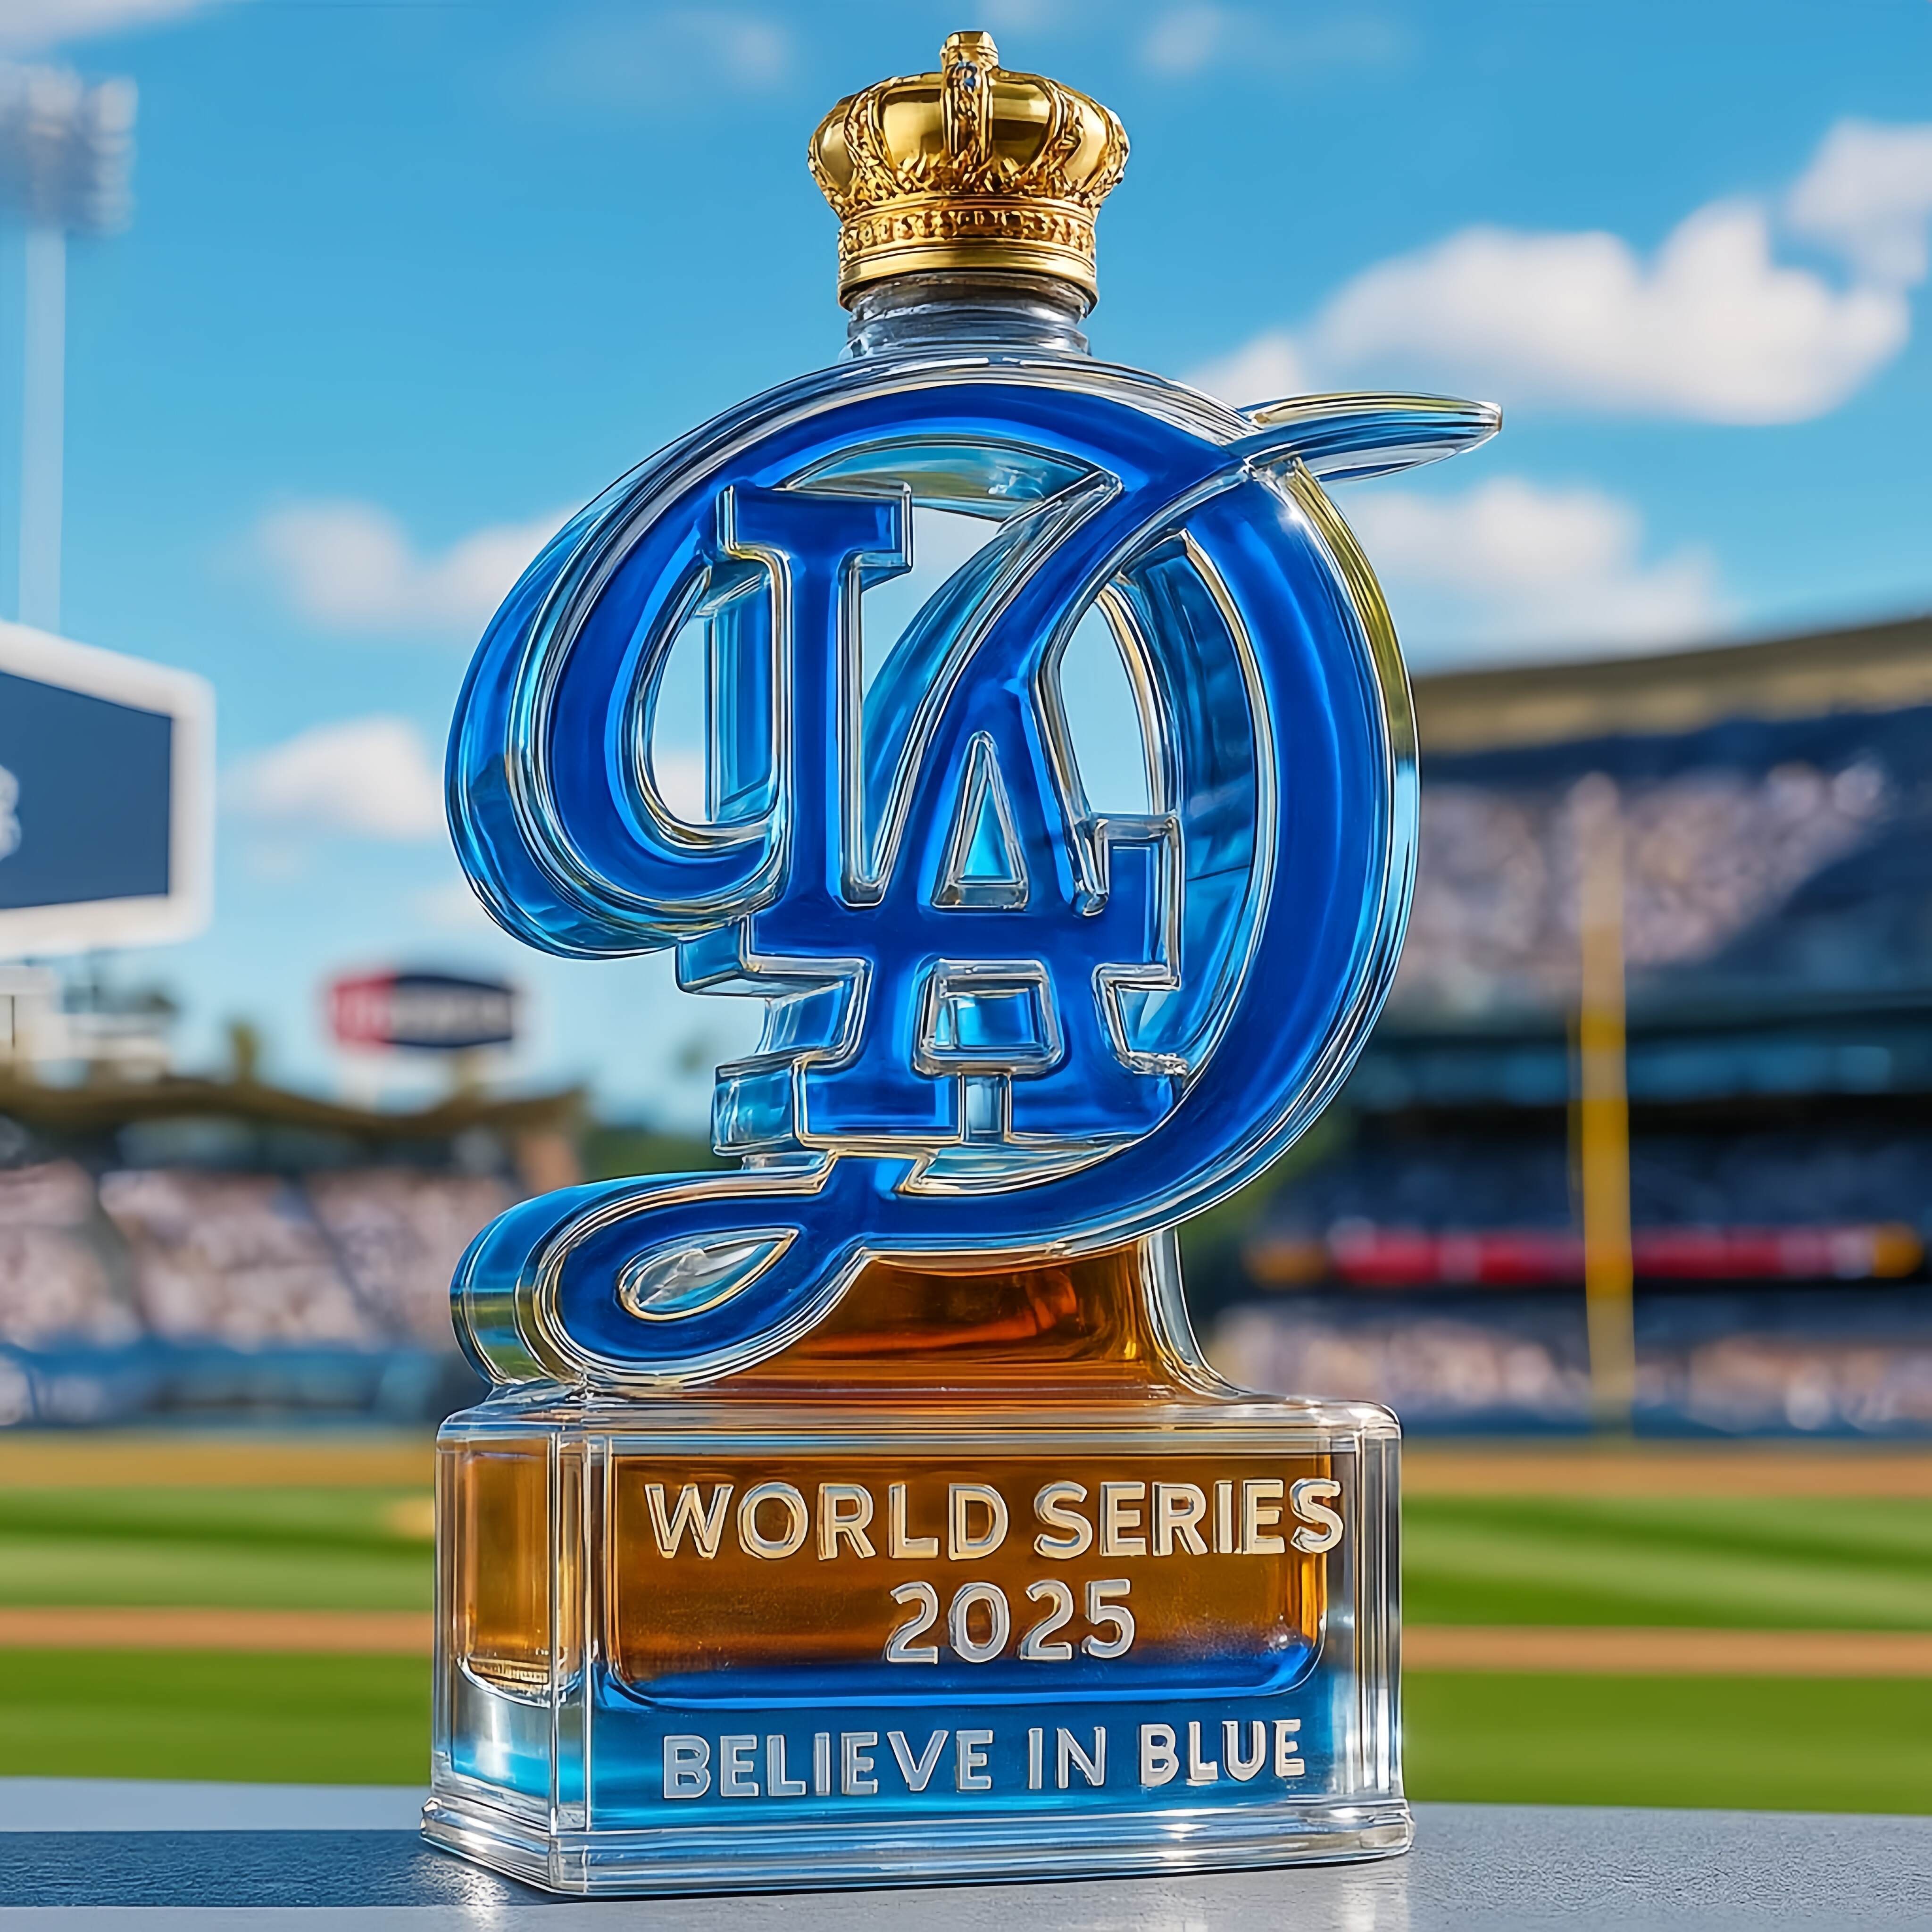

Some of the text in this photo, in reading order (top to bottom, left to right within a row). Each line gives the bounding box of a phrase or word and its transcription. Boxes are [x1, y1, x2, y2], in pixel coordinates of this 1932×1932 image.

[644, 1478, 1344, 1560] WORLD SERIES
[885, 1578, 1135, 1664] 2025
[663, 1718, 1306, 1799] BELIEVE IN BLUE
